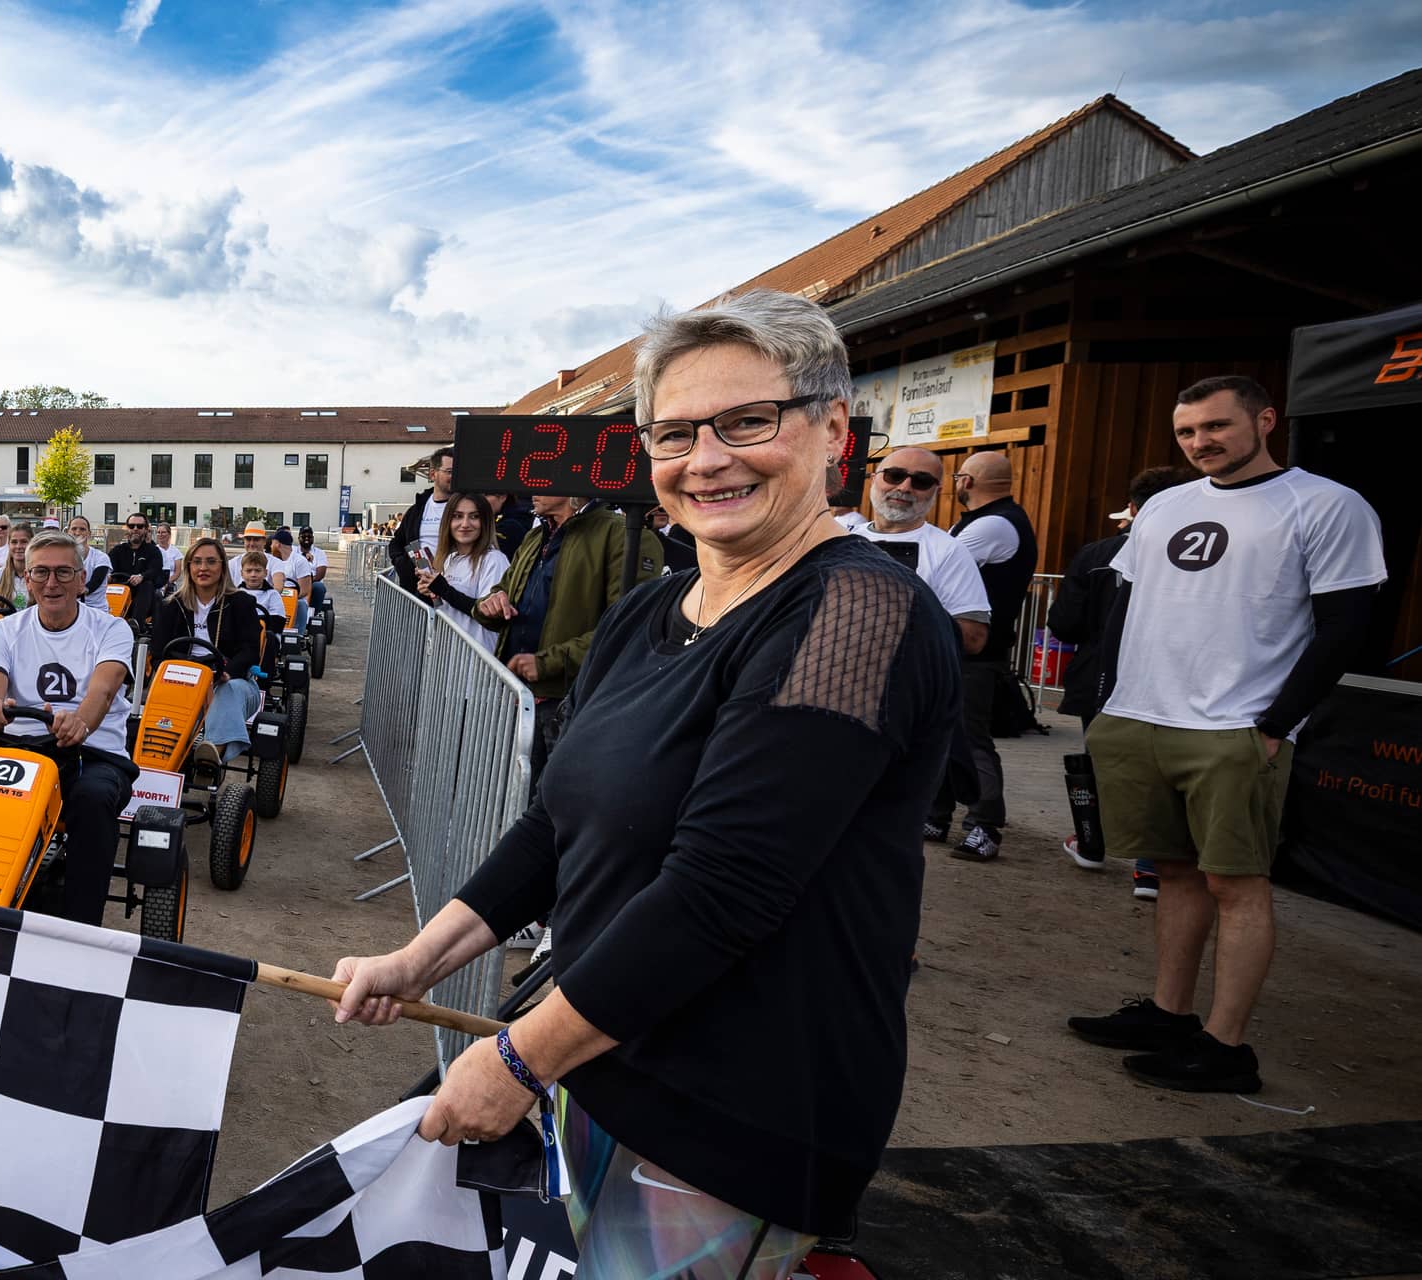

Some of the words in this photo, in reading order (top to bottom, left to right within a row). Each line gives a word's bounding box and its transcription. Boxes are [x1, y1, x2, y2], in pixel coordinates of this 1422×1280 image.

[901, 376, 953, 402] Familienlauf
[1178, 531, 1218, 561] 21
[44, 671, 68, 696] 21
[131, 789, 170, 803] LWORTH
[1317, 769, 1345, 790] Ihr
[1347, 776, 1394, 801] Profi
